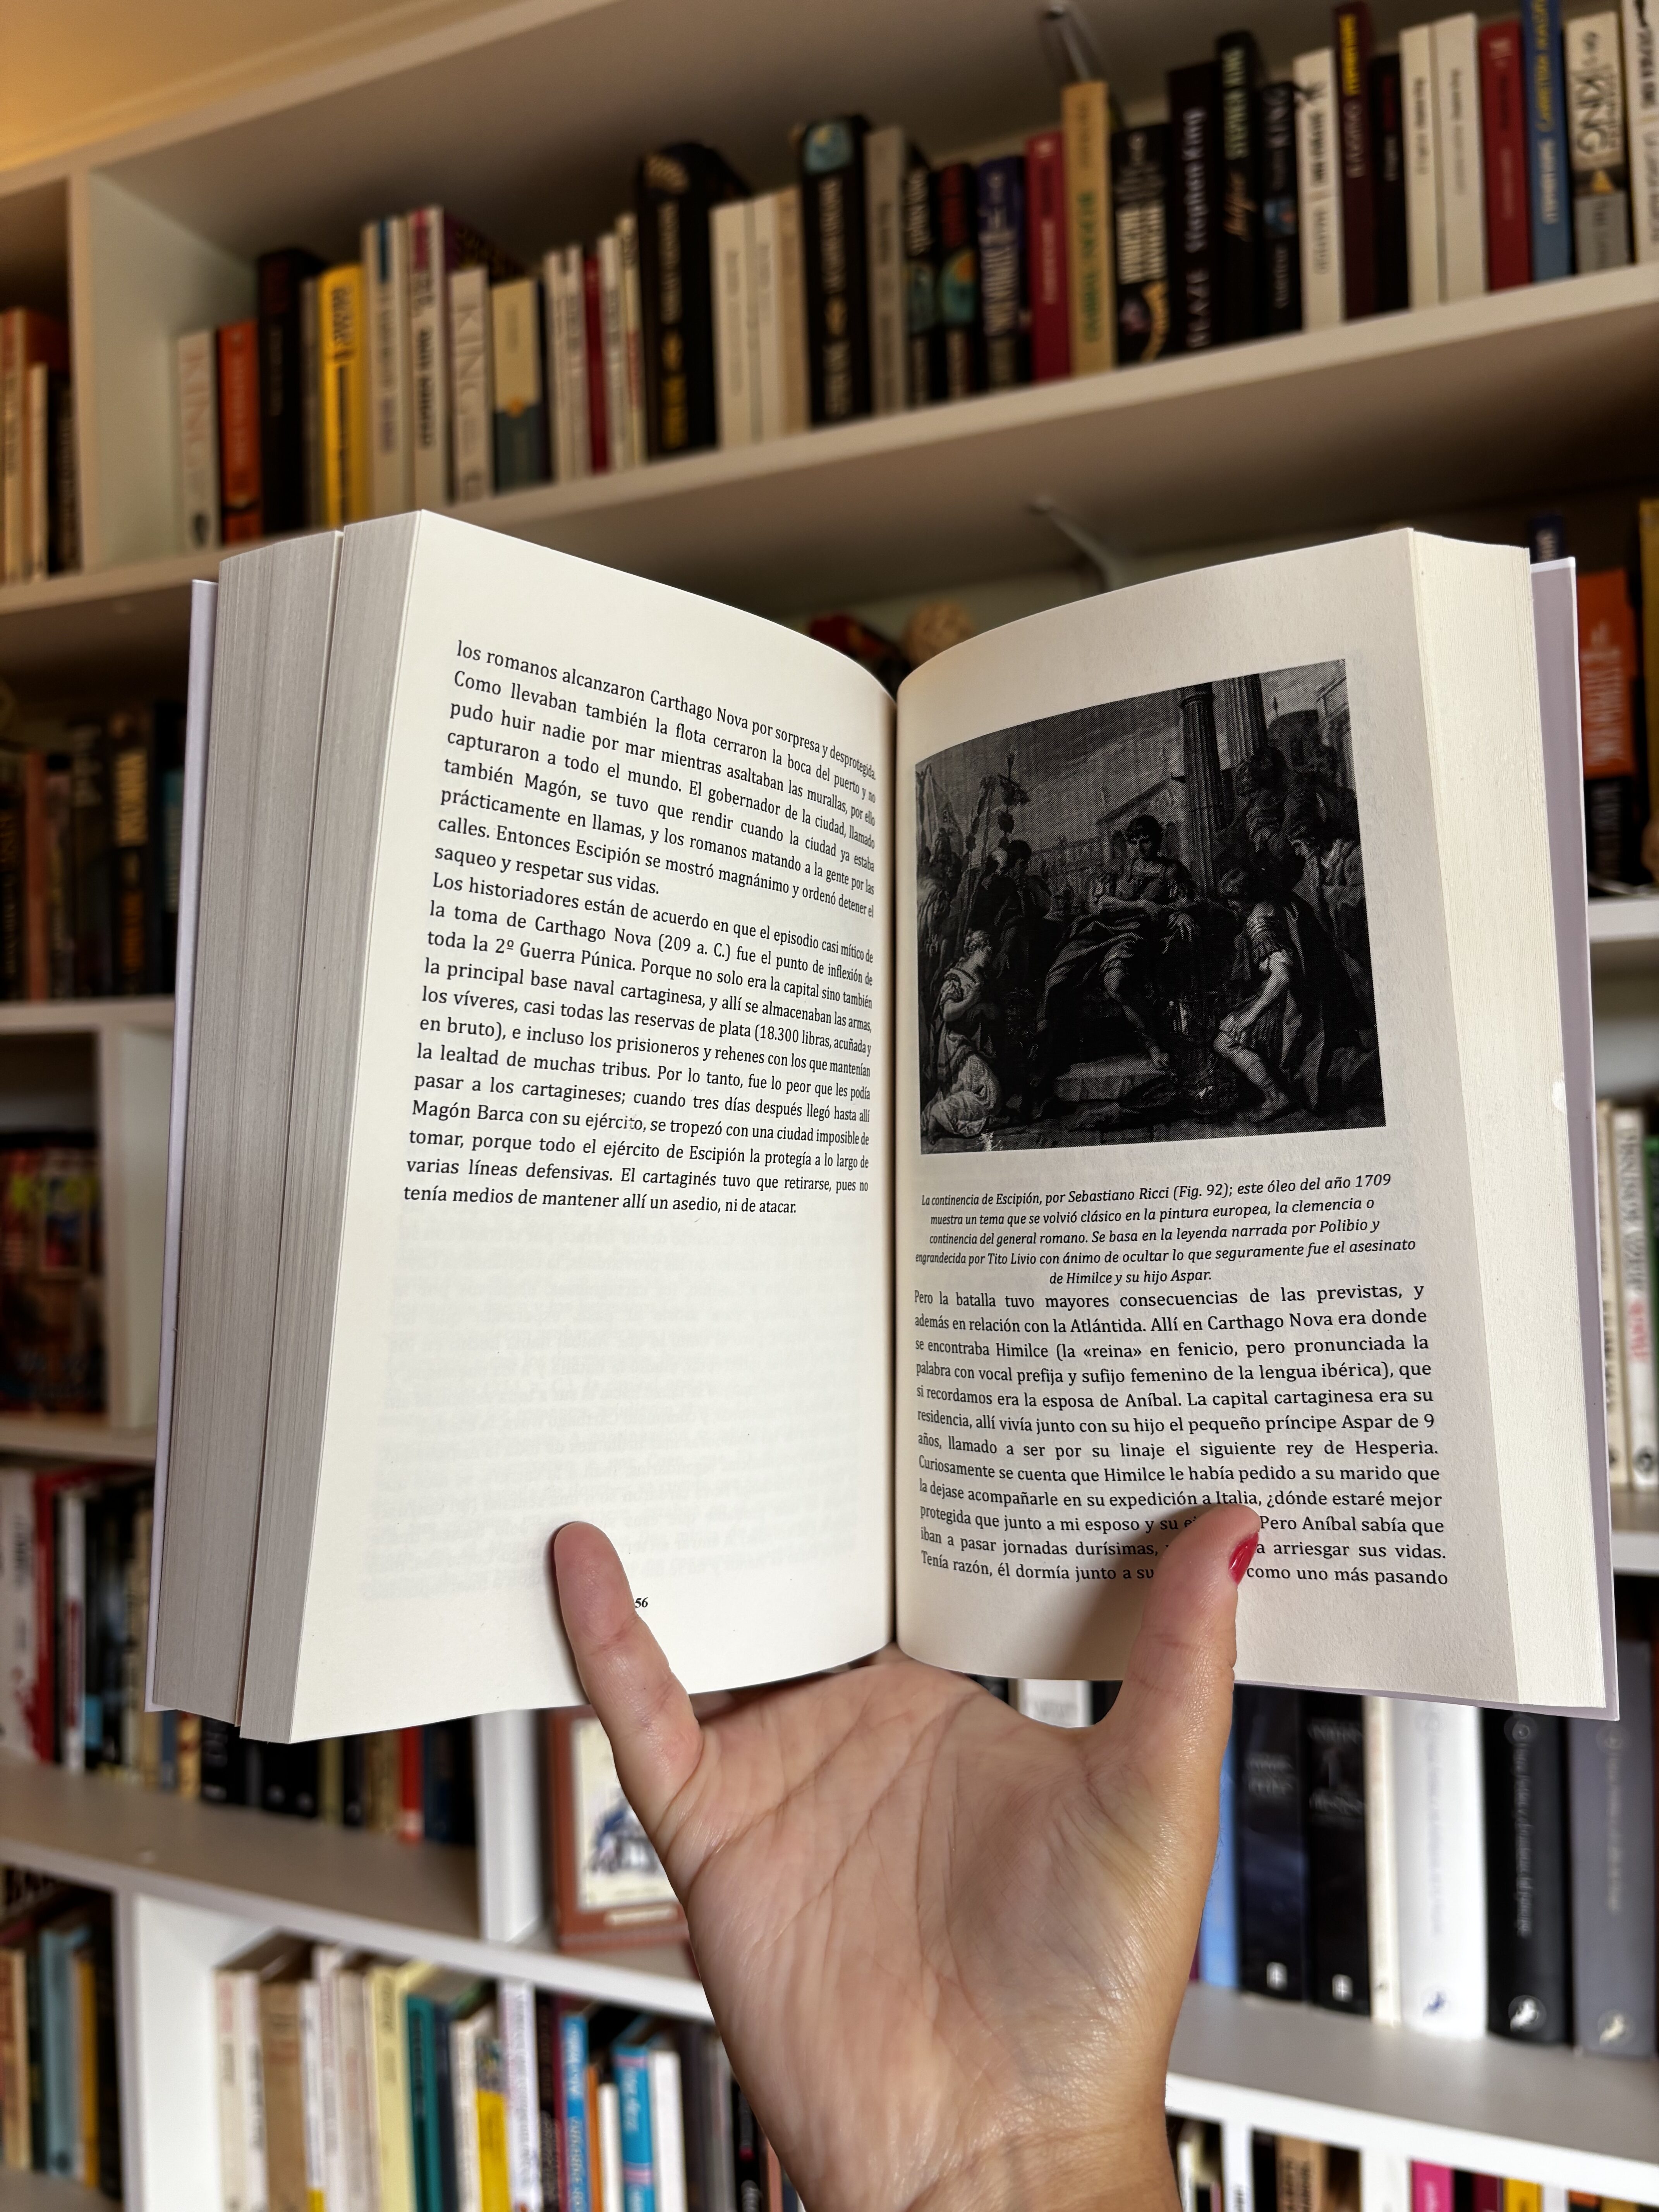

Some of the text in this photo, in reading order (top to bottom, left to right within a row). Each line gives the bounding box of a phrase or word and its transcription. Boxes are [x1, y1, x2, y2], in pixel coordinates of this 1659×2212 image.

[457, 639, 876, 780] los romanos alcanzaron Carthago Nova por sorpresa y desprotegida.
[448, 732, 874, 849] capturaron a todo el mundo. El gobernador de la ciudad, llamado
[438, 817, 874, 918] calles. Entonces Escipión se mostró magnánimo y ordenó detener el
[430, 900, 872, 986] la toma de Carthago Nova (209 a. C.) fue el punto de inflexión de
[414, 1075, 870, 1123] pasar a los cartagineses; cuando tres días después llegó hasta allí
[406, 1158, 868, 1194] varias líneas defensivas. El cartaginés tuvo que retirarse, pues no
[922, 1173, 1391, 1207] La continencia de Escipión, por Sebastiano Ricci (Fig. 92); este óleo del año 1709
[404, 1185, 796, 1213] tenía medios de mantener allí un asedio, ni de atacar.
[1050, 1269, 1211, 1286] de Himilce y su hijo Aspar.
[914, 1285, 1424, 1311] Pero la batalla tuvo mayores consecuencias de las previstas, y
[915, 1334, 1429, 1361] se encontraba Himilce (la «reina» en fenicio, pero pronunciada la
[917, 1384, 1434, 1411] si recordamos era la esposa de Aníbal. La capital cartaginesa era su
[918, 1432, 1439, 1461] años, llamado a ser por su linaje el siguiente rey de Hesperia.
